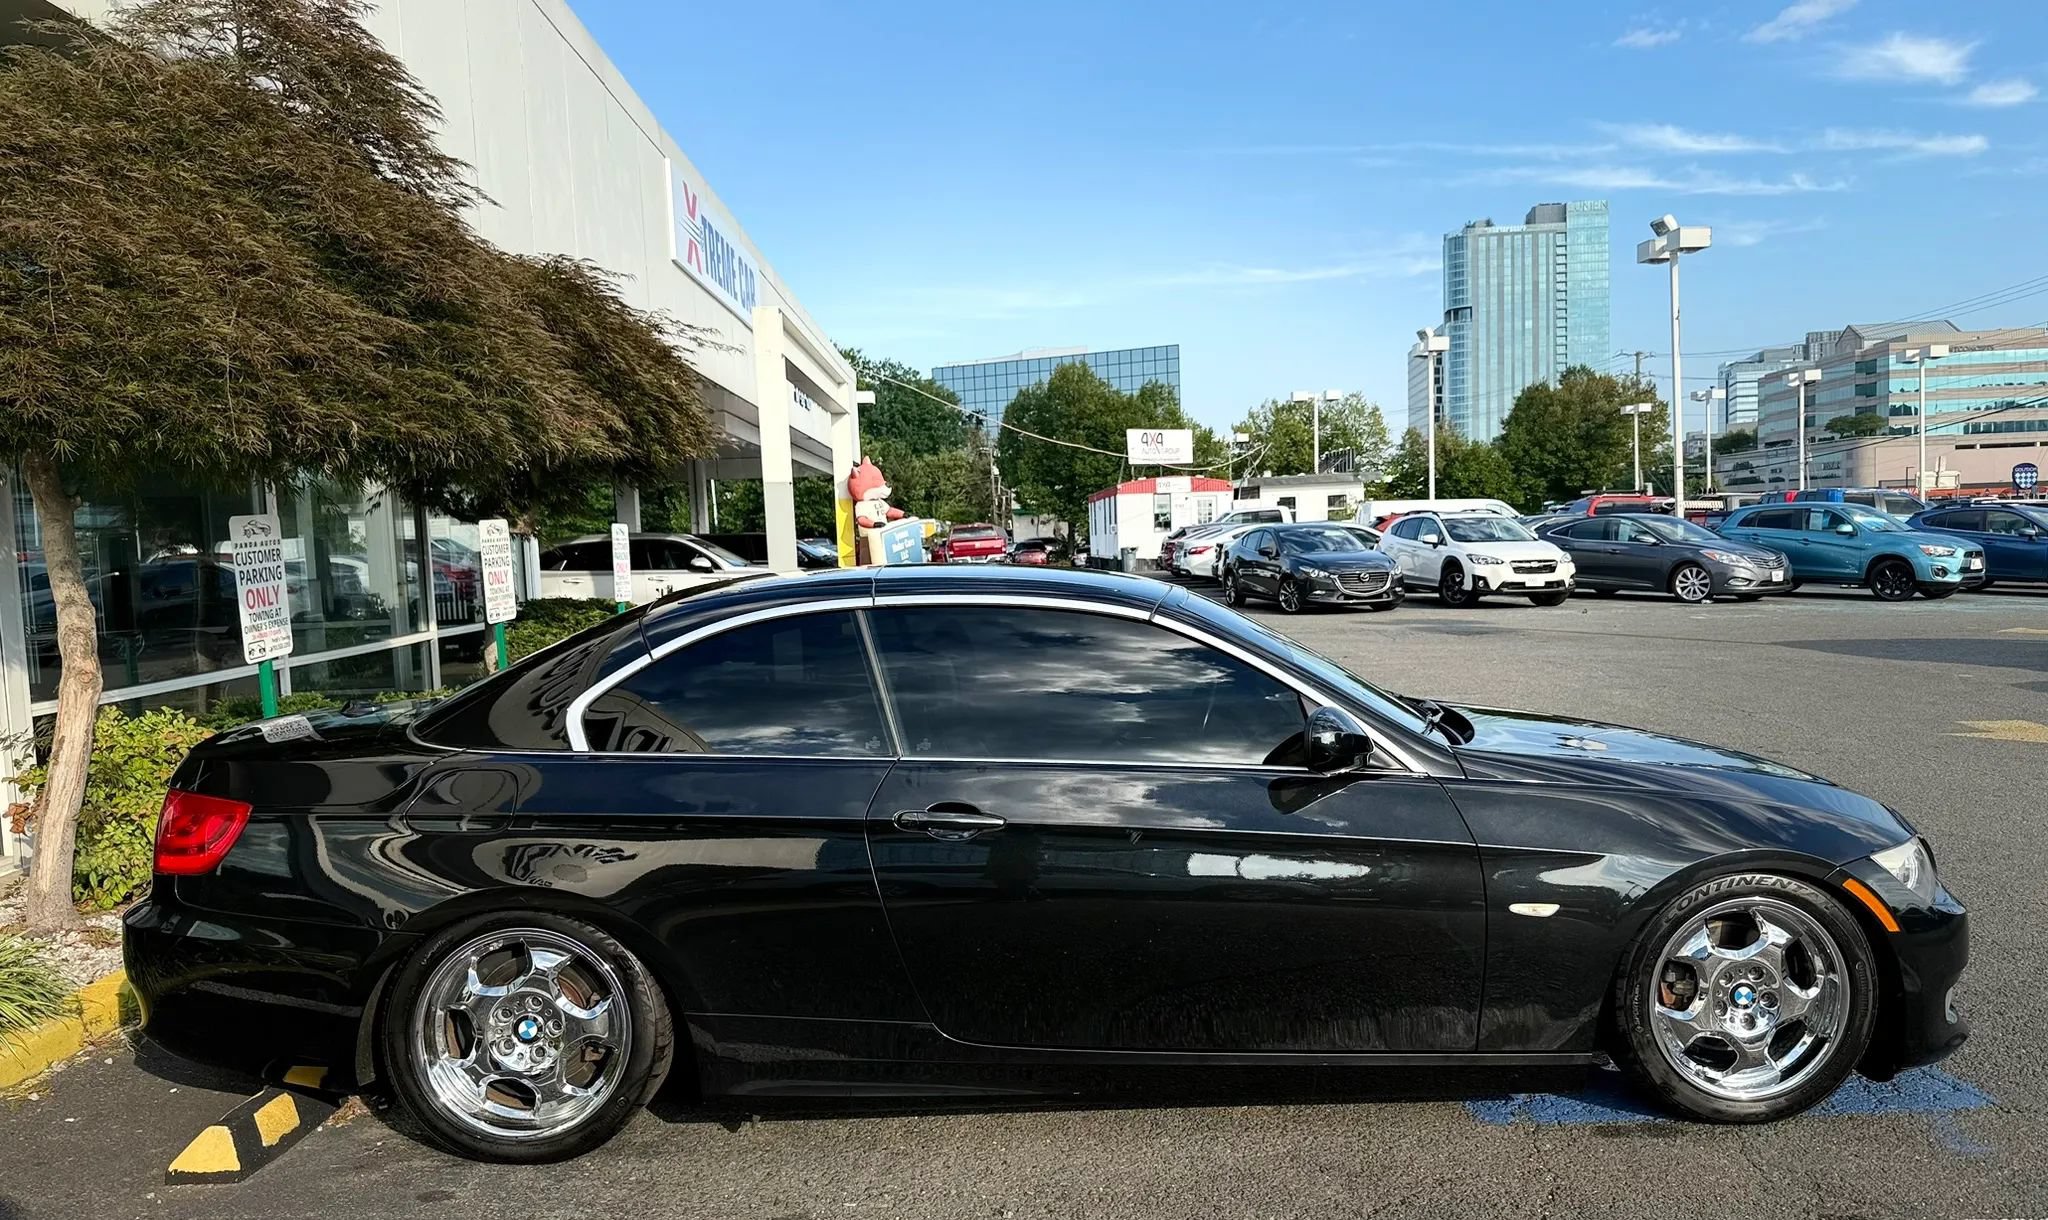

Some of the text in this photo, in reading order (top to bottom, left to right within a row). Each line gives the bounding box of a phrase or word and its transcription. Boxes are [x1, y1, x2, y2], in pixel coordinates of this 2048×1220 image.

[682, 180, 757, 314] XTREME CAR
[234, 538, 281, 549] PANDA AUTOS
[482, 543, 509, 556] CUSTOMER
[235, 548, 282, 566] CUSTOMER
[484, 555, 511, 568] PARKING
[239, 565, 282, 586] PARKING
[488, 570, 508, 586] ONLY
[246, 584, 279, 609] ONLY
[249, 607, 282, 622] TOWING AT
[244, 617, 289, 635] OWNER'S EXPENSE
